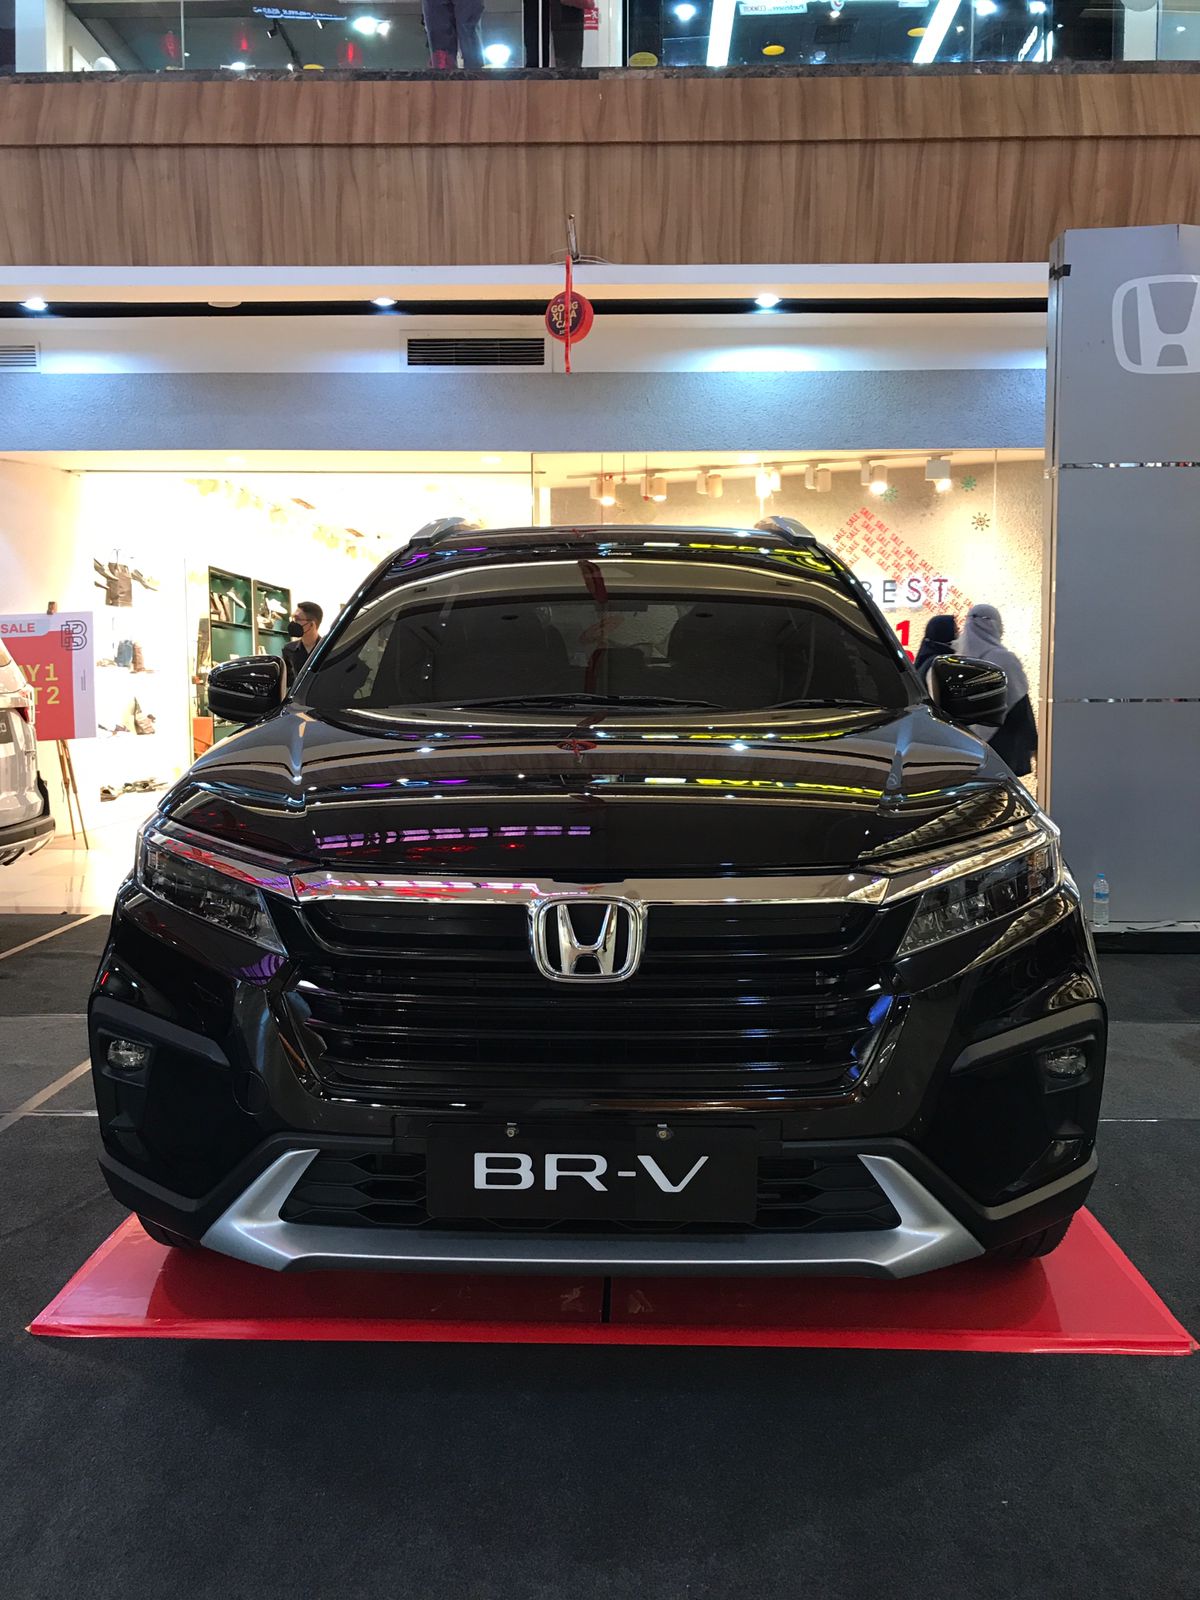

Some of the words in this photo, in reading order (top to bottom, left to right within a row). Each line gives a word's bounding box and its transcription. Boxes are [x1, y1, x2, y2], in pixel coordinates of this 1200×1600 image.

[551, 301, 578, 313] GOG
[1, 623, 35, 634] SALE
[46, 686, 60, 705] 2
[474, 1152, 709, 1193] BR-V
